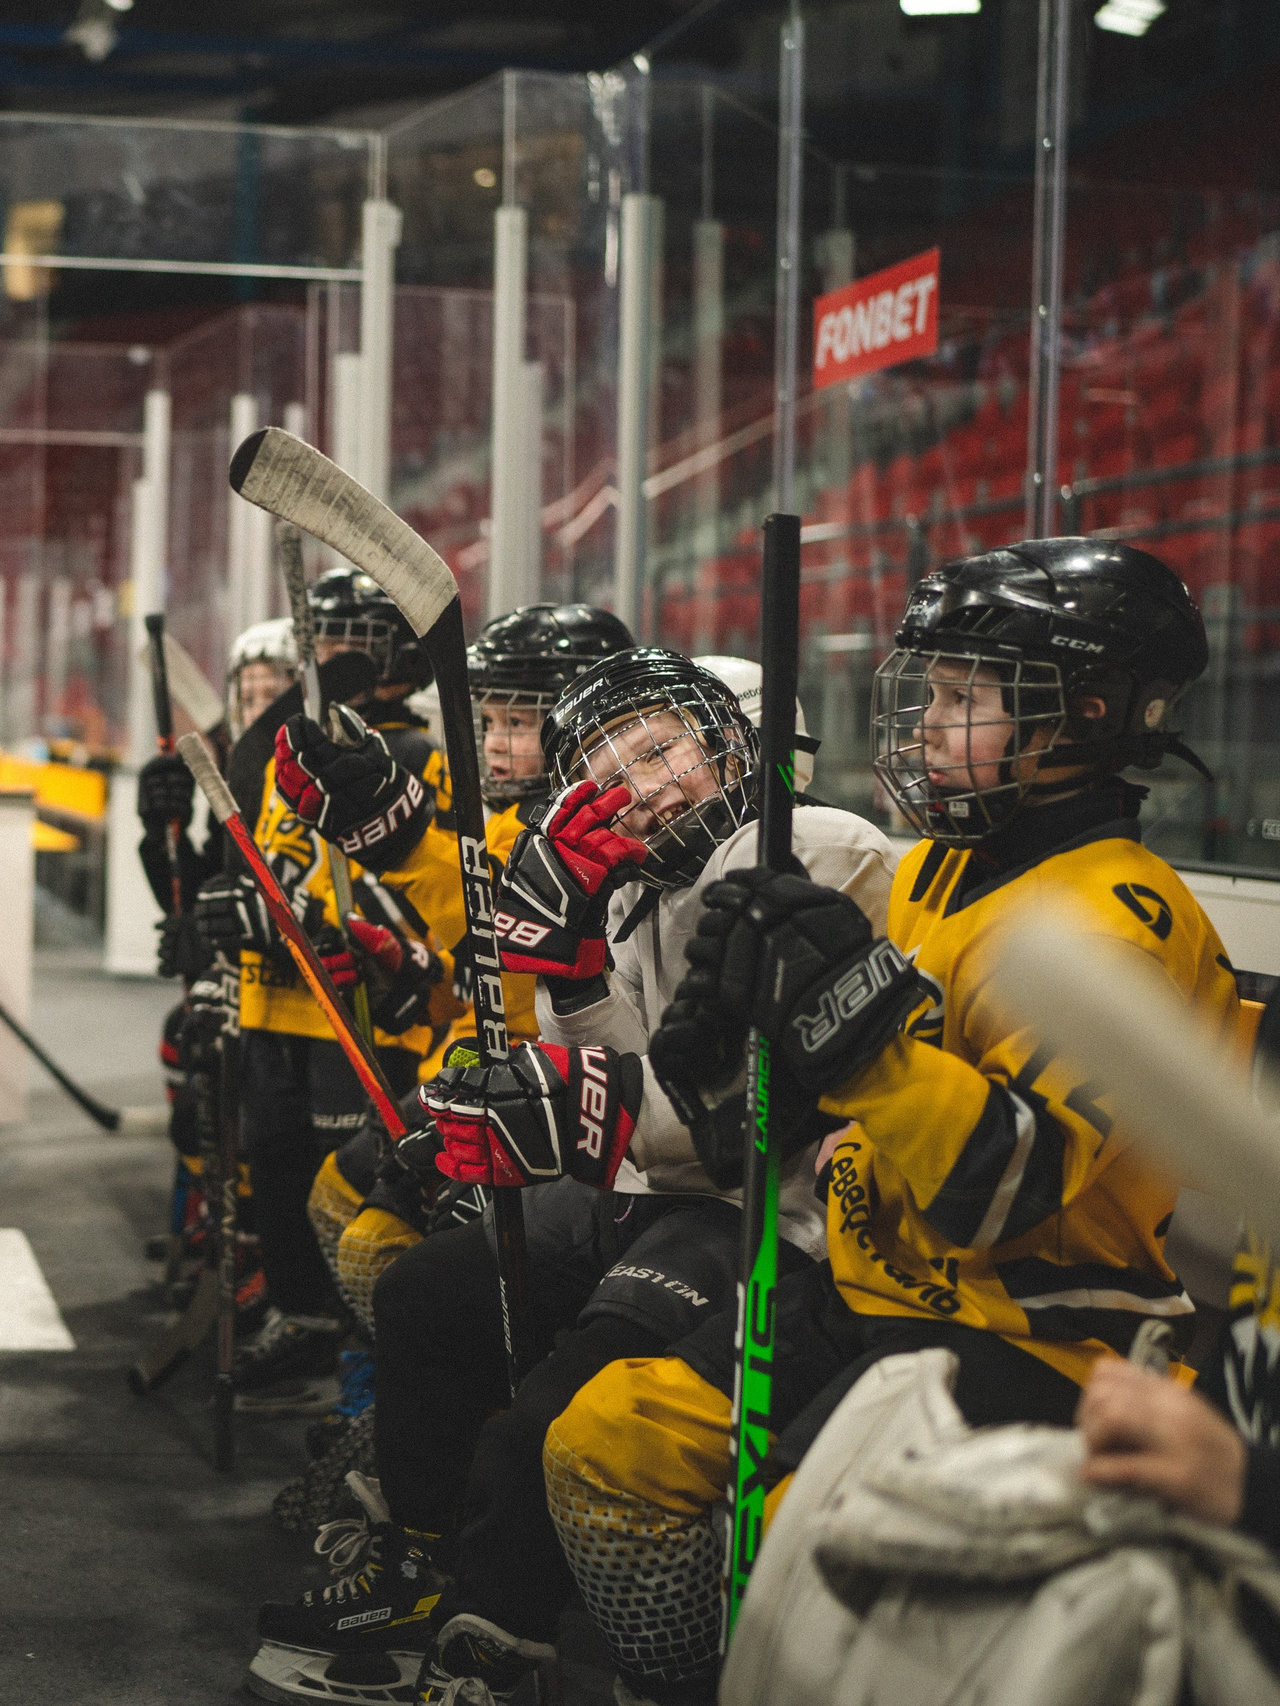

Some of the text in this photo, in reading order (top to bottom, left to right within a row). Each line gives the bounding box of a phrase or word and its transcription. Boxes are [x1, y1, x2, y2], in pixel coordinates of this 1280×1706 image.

[815, 272, 936, 369] FONBET
[1051, 635, 1105, 653] CCM
[555, 678, 604, 722] BAUER
[736, 685, 763, 702] eebo
[336, 773, 424, 854] AUER
[792, 938, 908, 1053] UER
[576, 1045, 608, 1159] UER
[606, 1264, 710, 1307] EASTON
[340, 1609, 389, 1628] BAUER
